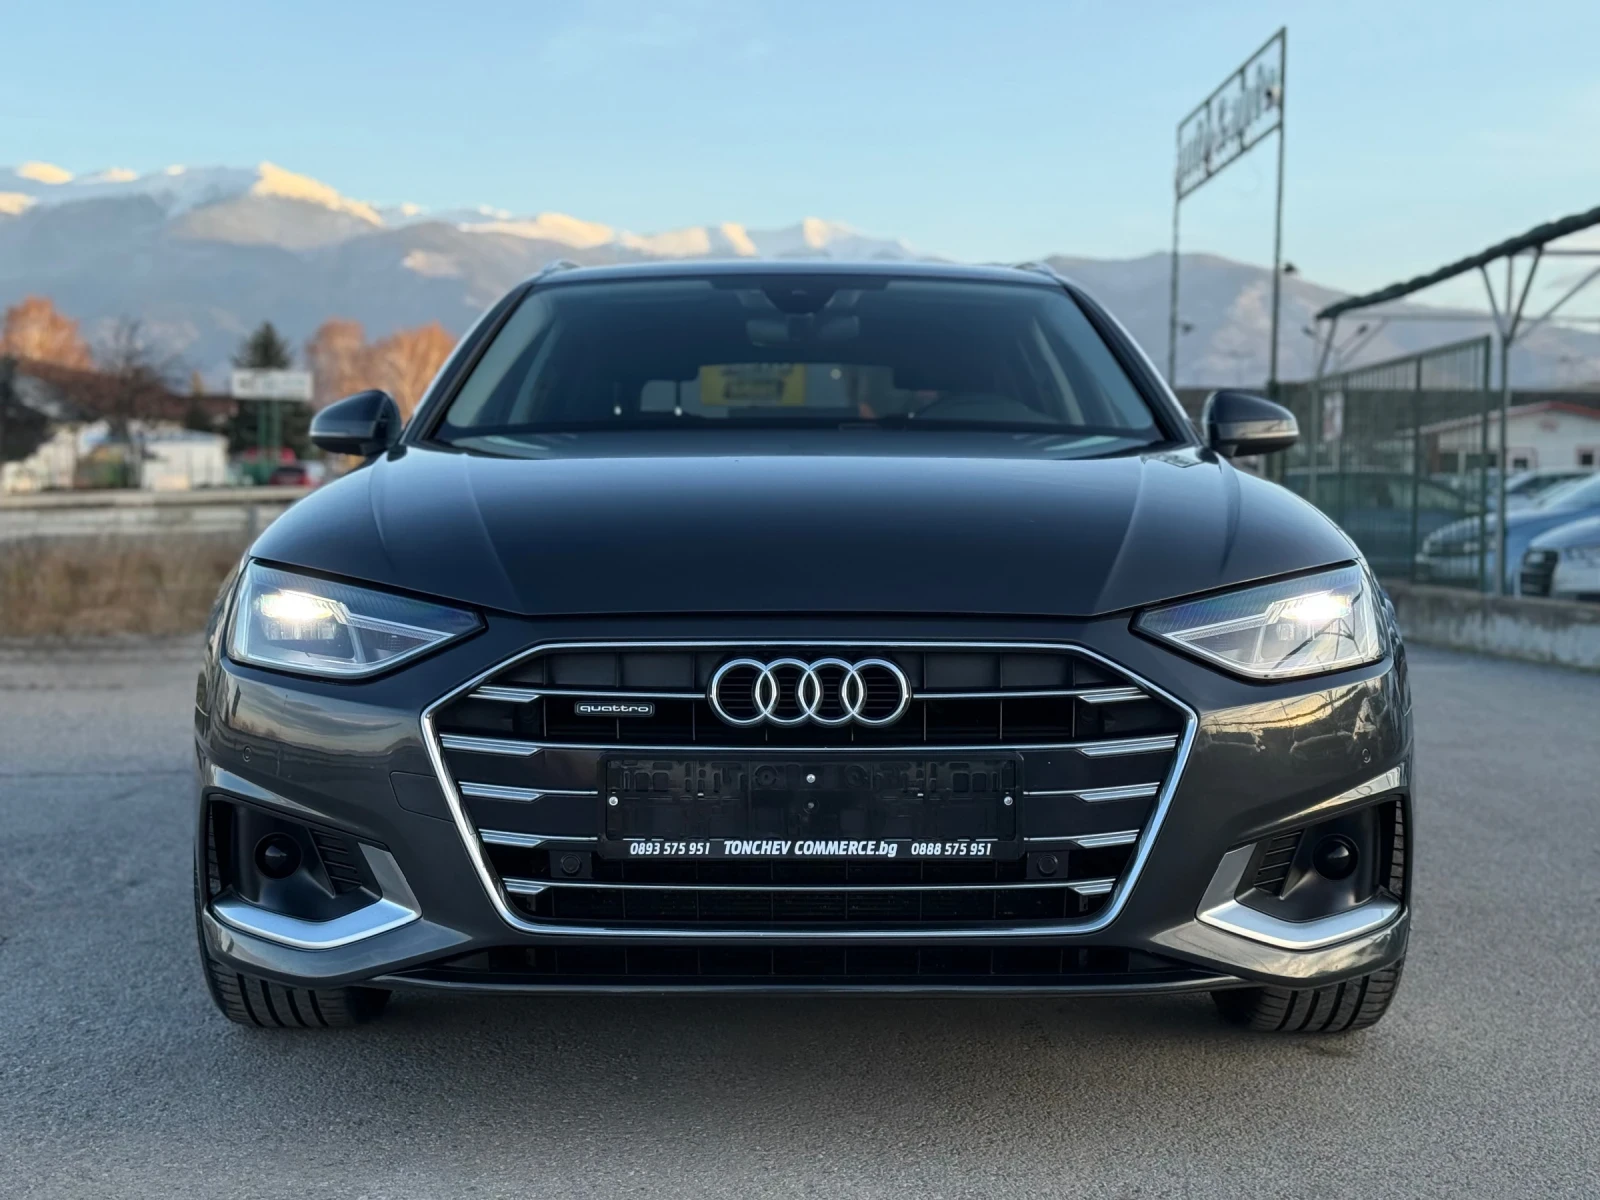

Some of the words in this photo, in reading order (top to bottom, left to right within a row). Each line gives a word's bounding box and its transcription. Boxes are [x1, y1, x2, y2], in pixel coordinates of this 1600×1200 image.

[579, 704, 649, 713] quattro
[630, 842, 660, 855] 0893
[663, 842, 686, 855] 575
[689, 842, 710, 855] 951
[724, 840, 791, 855] TONCHEV
[794, 840, 898, 858] COMMERCE.bg
[911, 843, 942, 855] 0888
[944, 843, 967, 855] 575
[969, 843, 992, 856] 951
